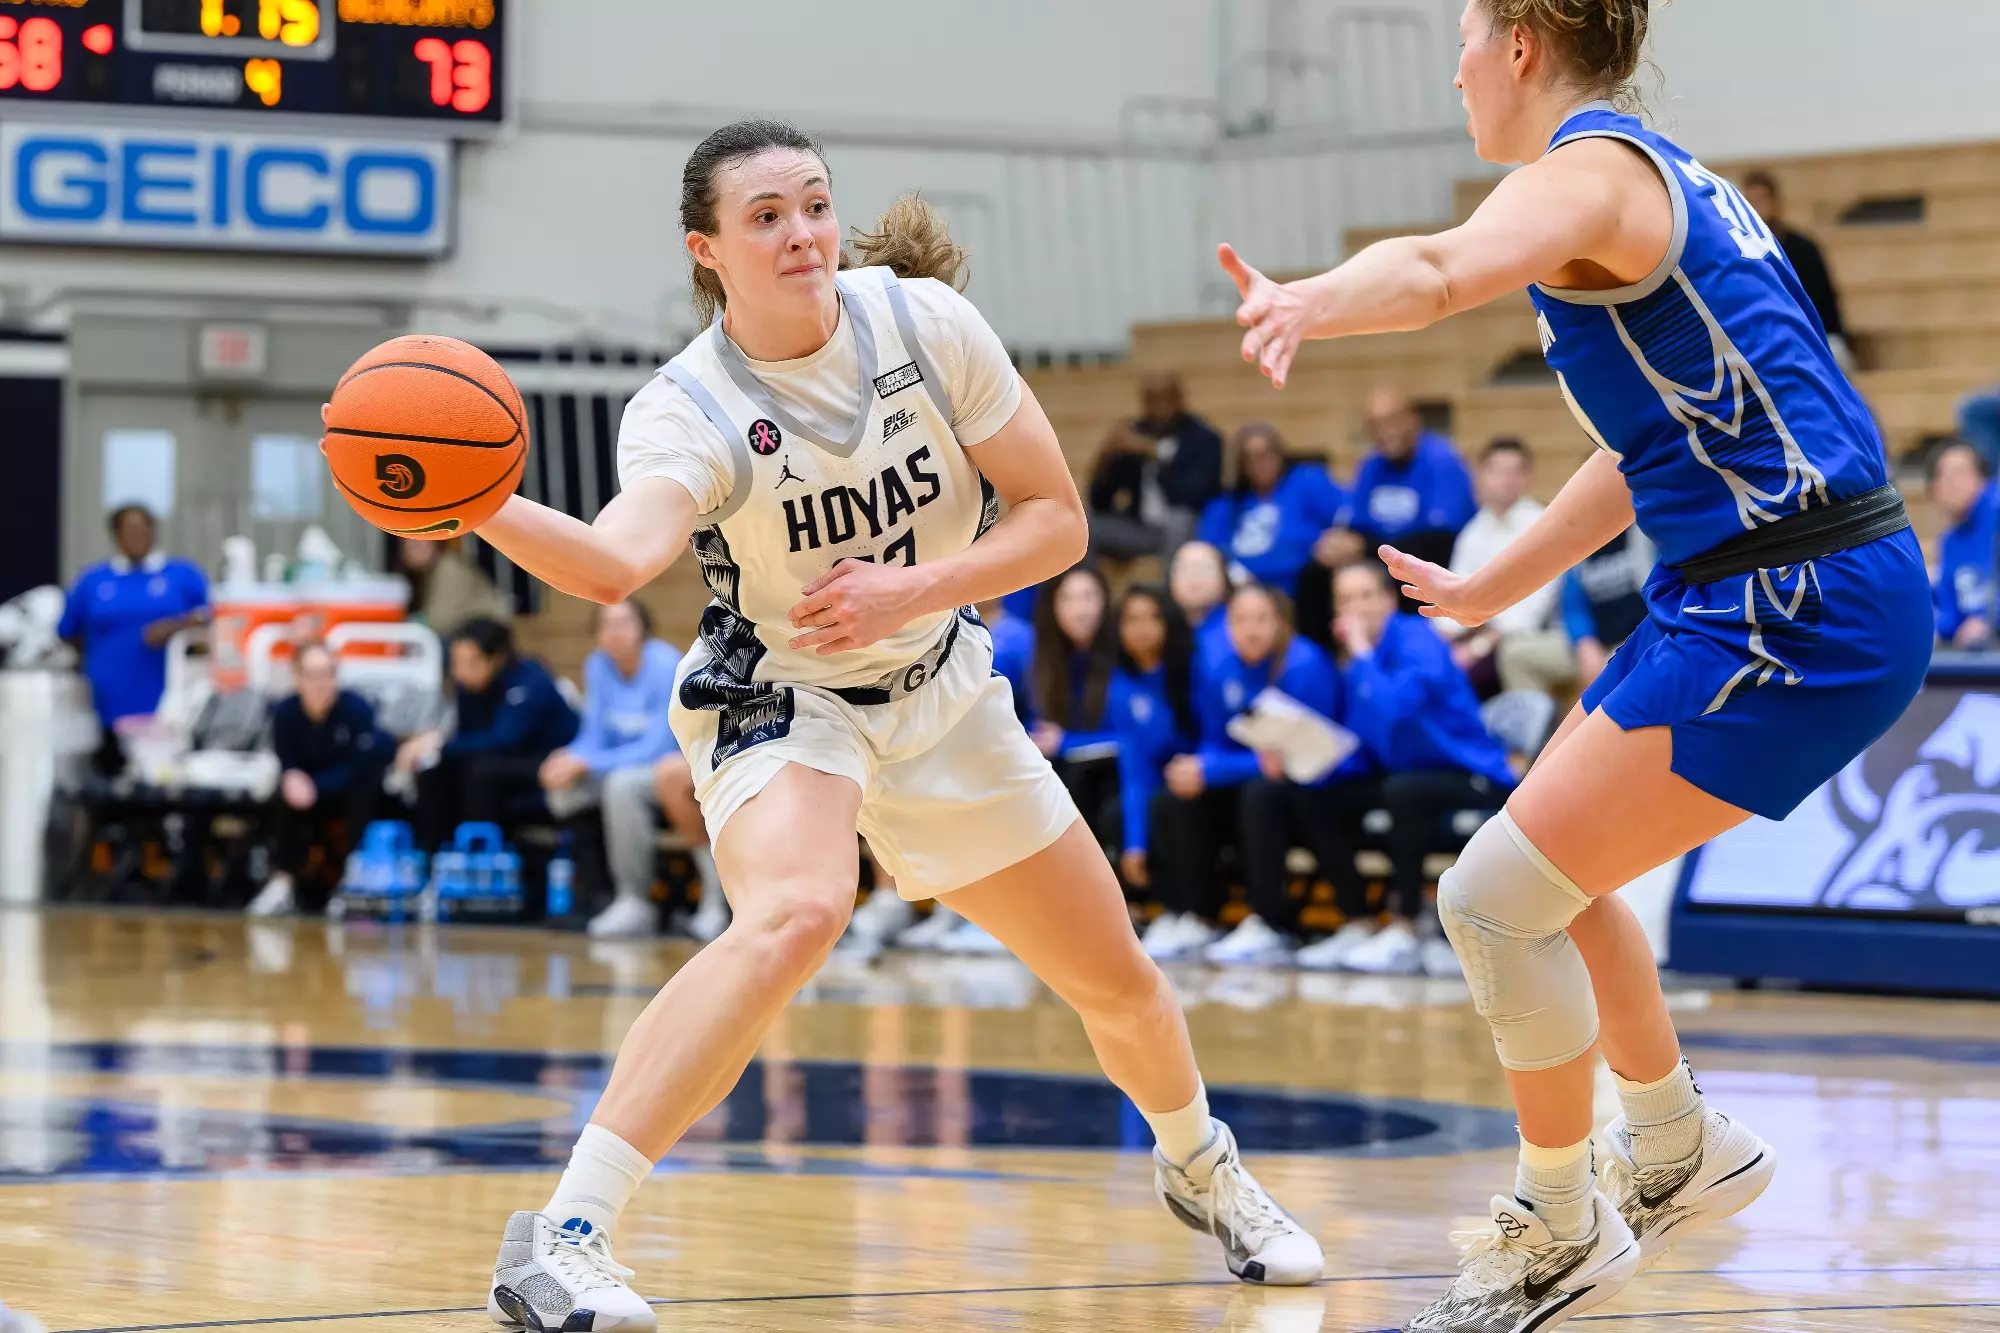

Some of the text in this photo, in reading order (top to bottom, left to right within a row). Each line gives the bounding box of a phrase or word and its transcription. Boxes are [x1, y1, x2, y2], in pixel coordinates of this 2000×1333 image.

[244, 57, 281, 107] 4
[414, 37, 491, 113] 73
[17, 135, 437, 237] GEICO
[879, 372, 921, 397] CHANGE
[883, 408, 906, 429] BIG
[883, 411, 917, 438] EAST
[782, 444, 941, 553] HOYAS
[903, 662, 928, 694] G
